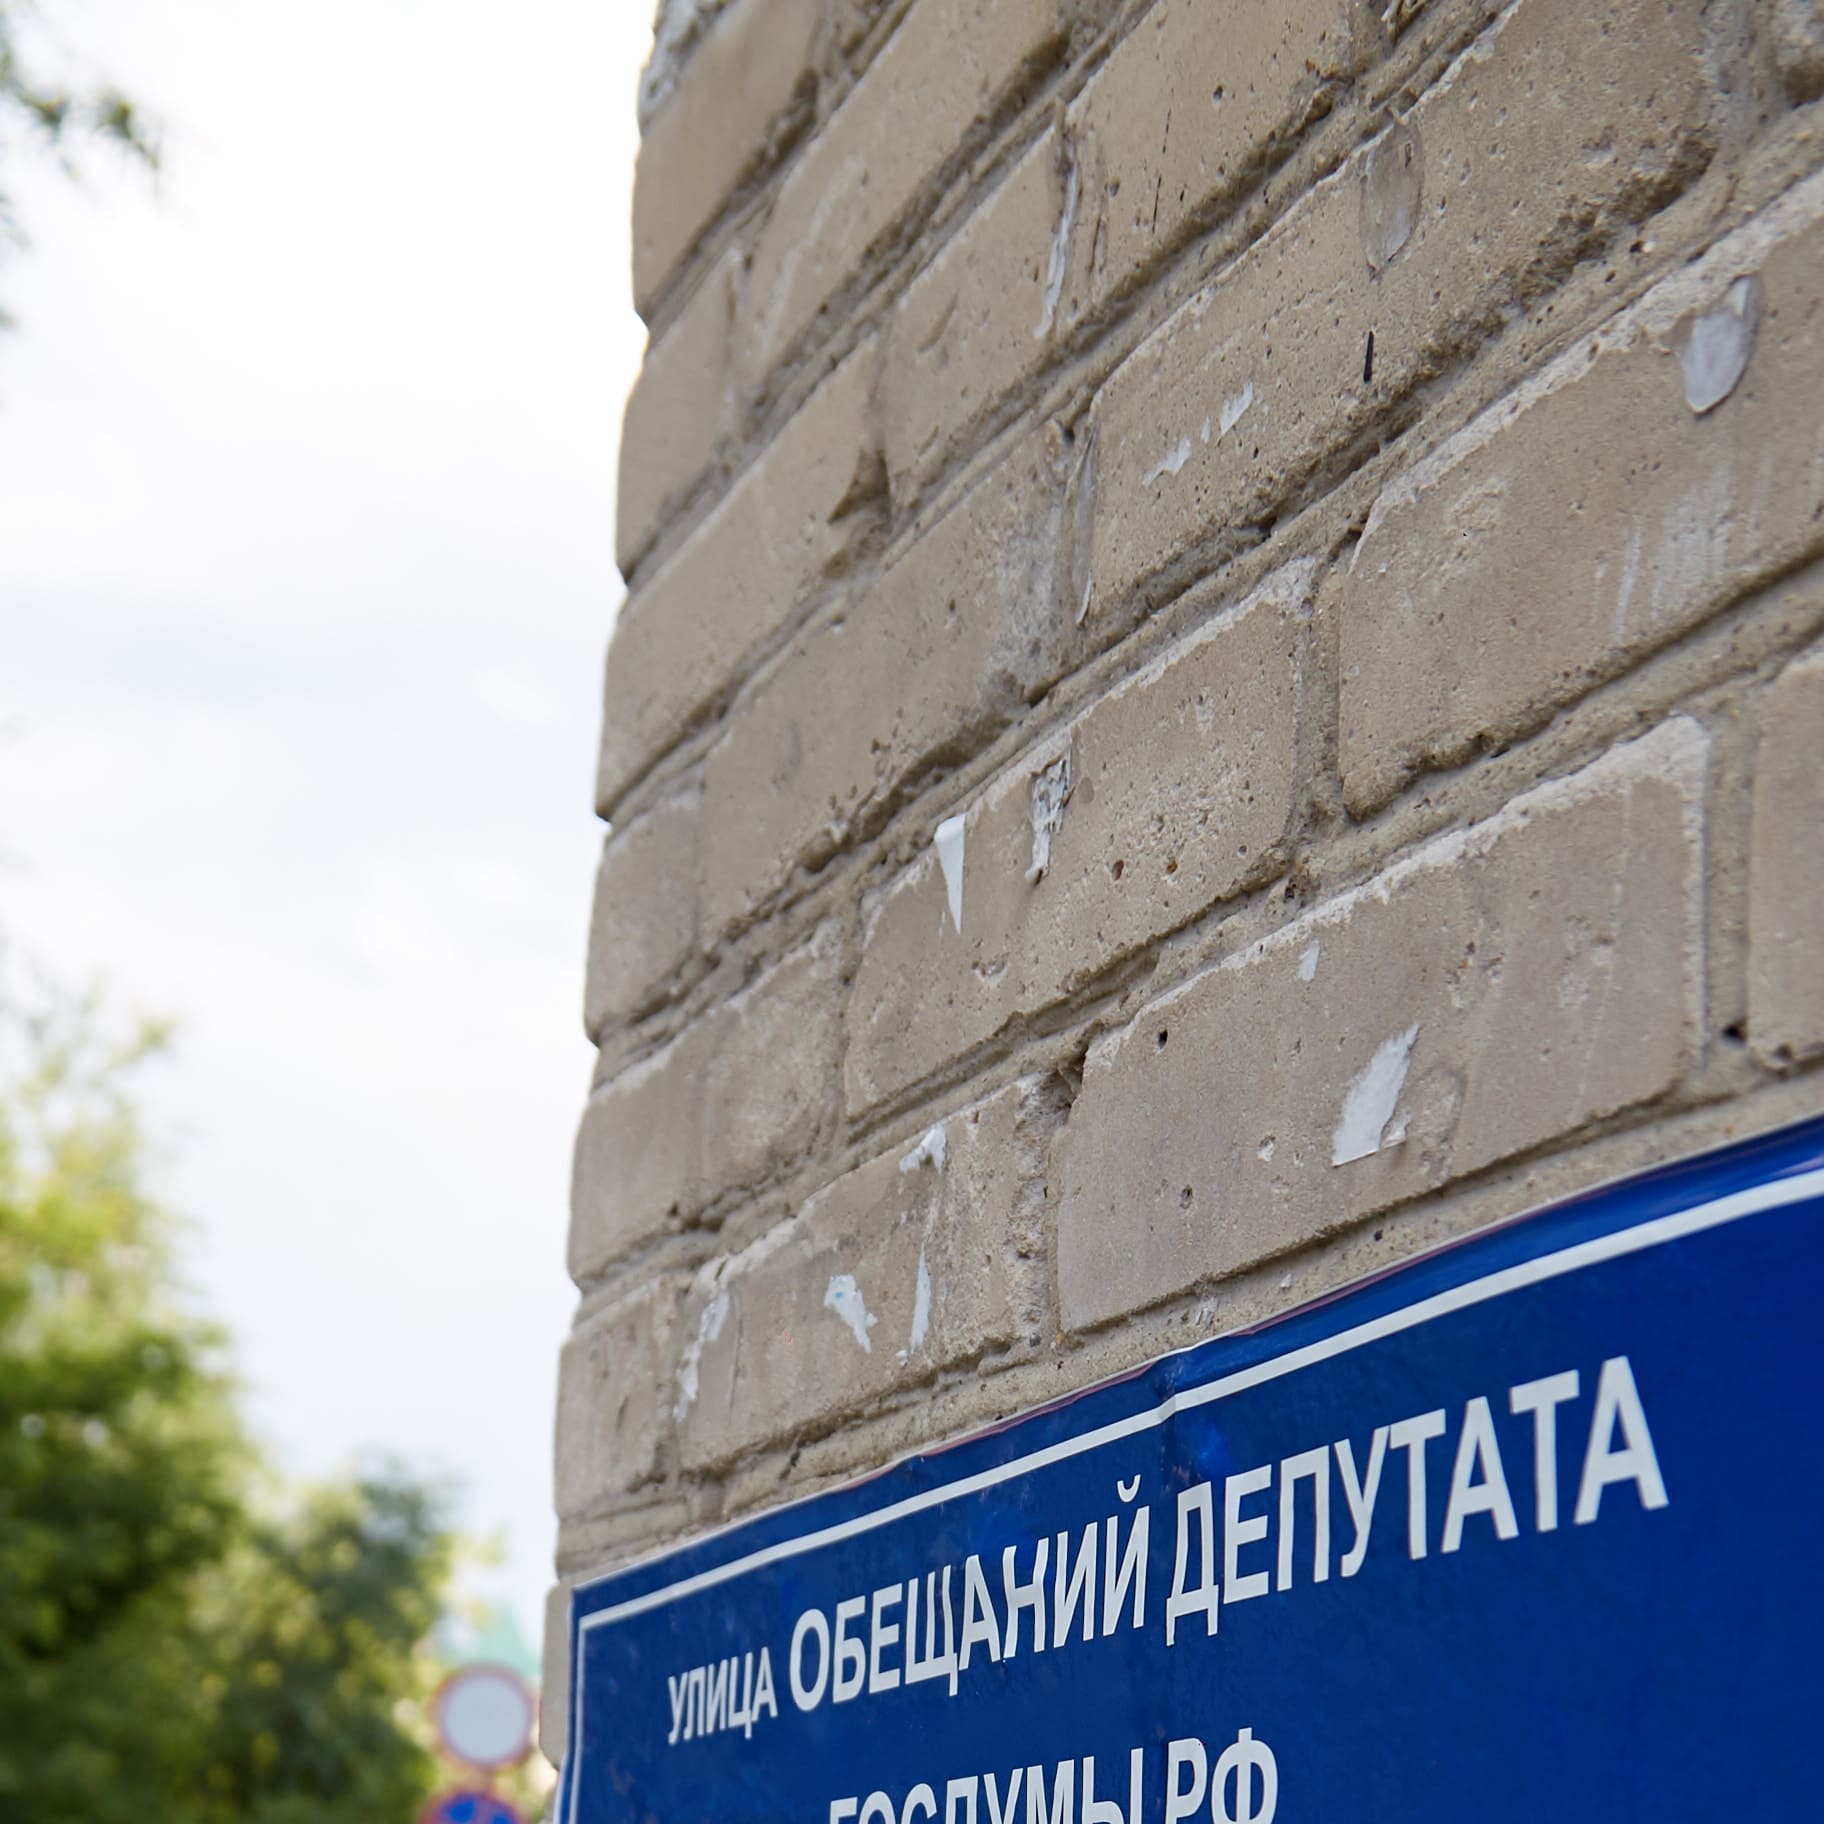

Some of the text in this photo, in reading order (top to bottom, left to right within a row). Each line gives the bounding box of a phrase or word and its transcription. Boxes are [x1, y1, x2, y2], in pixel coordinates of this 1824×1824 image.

[667, 1356, 1669, 1745] УЛИЦА ОБЕЩАНИЙ ДЕПУТАТА
